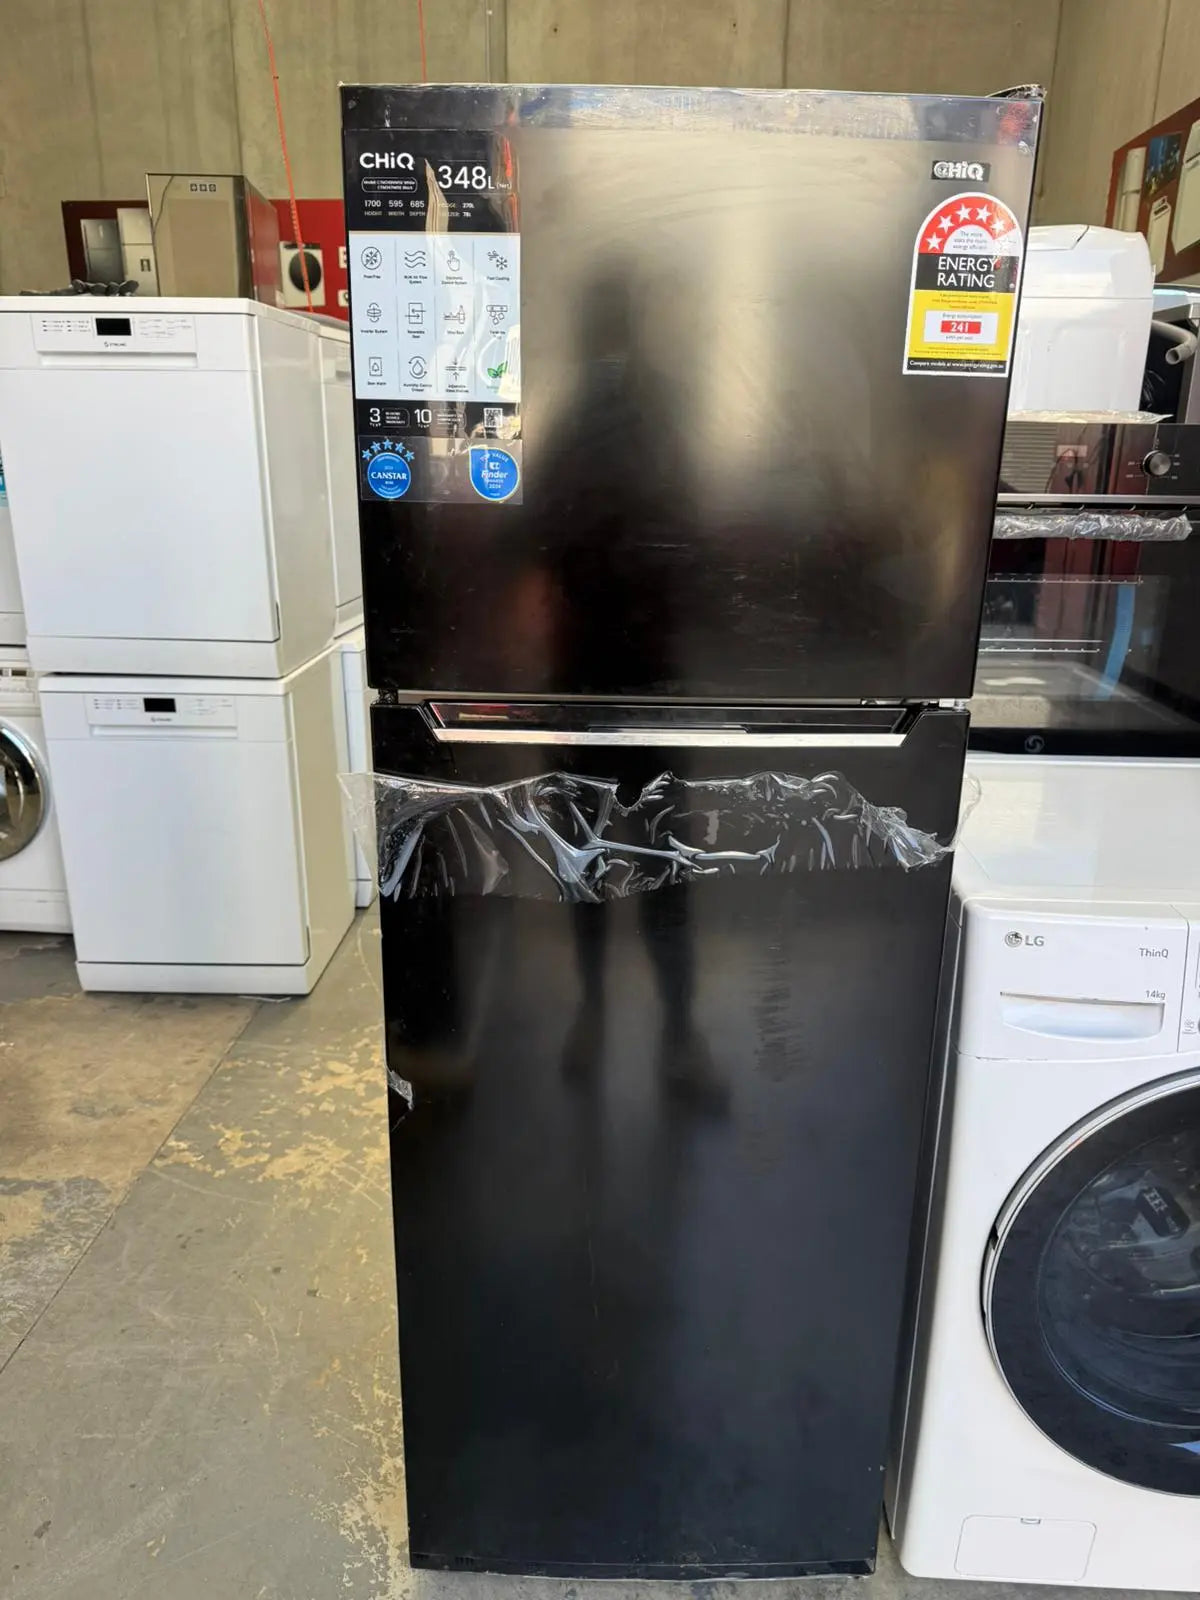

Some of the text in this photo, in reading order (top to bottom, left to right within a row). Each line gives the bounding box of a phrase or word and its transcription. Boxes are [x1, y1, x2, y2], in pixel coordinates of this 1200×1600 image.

[359, 152, 415, 171] CHiQ
[388, 200, 404, 208] 595
[410, 200, 425, 208] 685
[938, 256, 998, 272] ENERGY
[937, 273, 996, 288] RATING
[951, 321, 969, 333] 241
[369, 408, 381, 423] 3
[414, 408, 432, 424] 10
[371, 471, 408, 480] CANSTAR
[1025, 936, 1045, 947] LG
[1139, 947, 1169, 959] ThinQ
[1145, 990, 1166, 1000] 14kg
